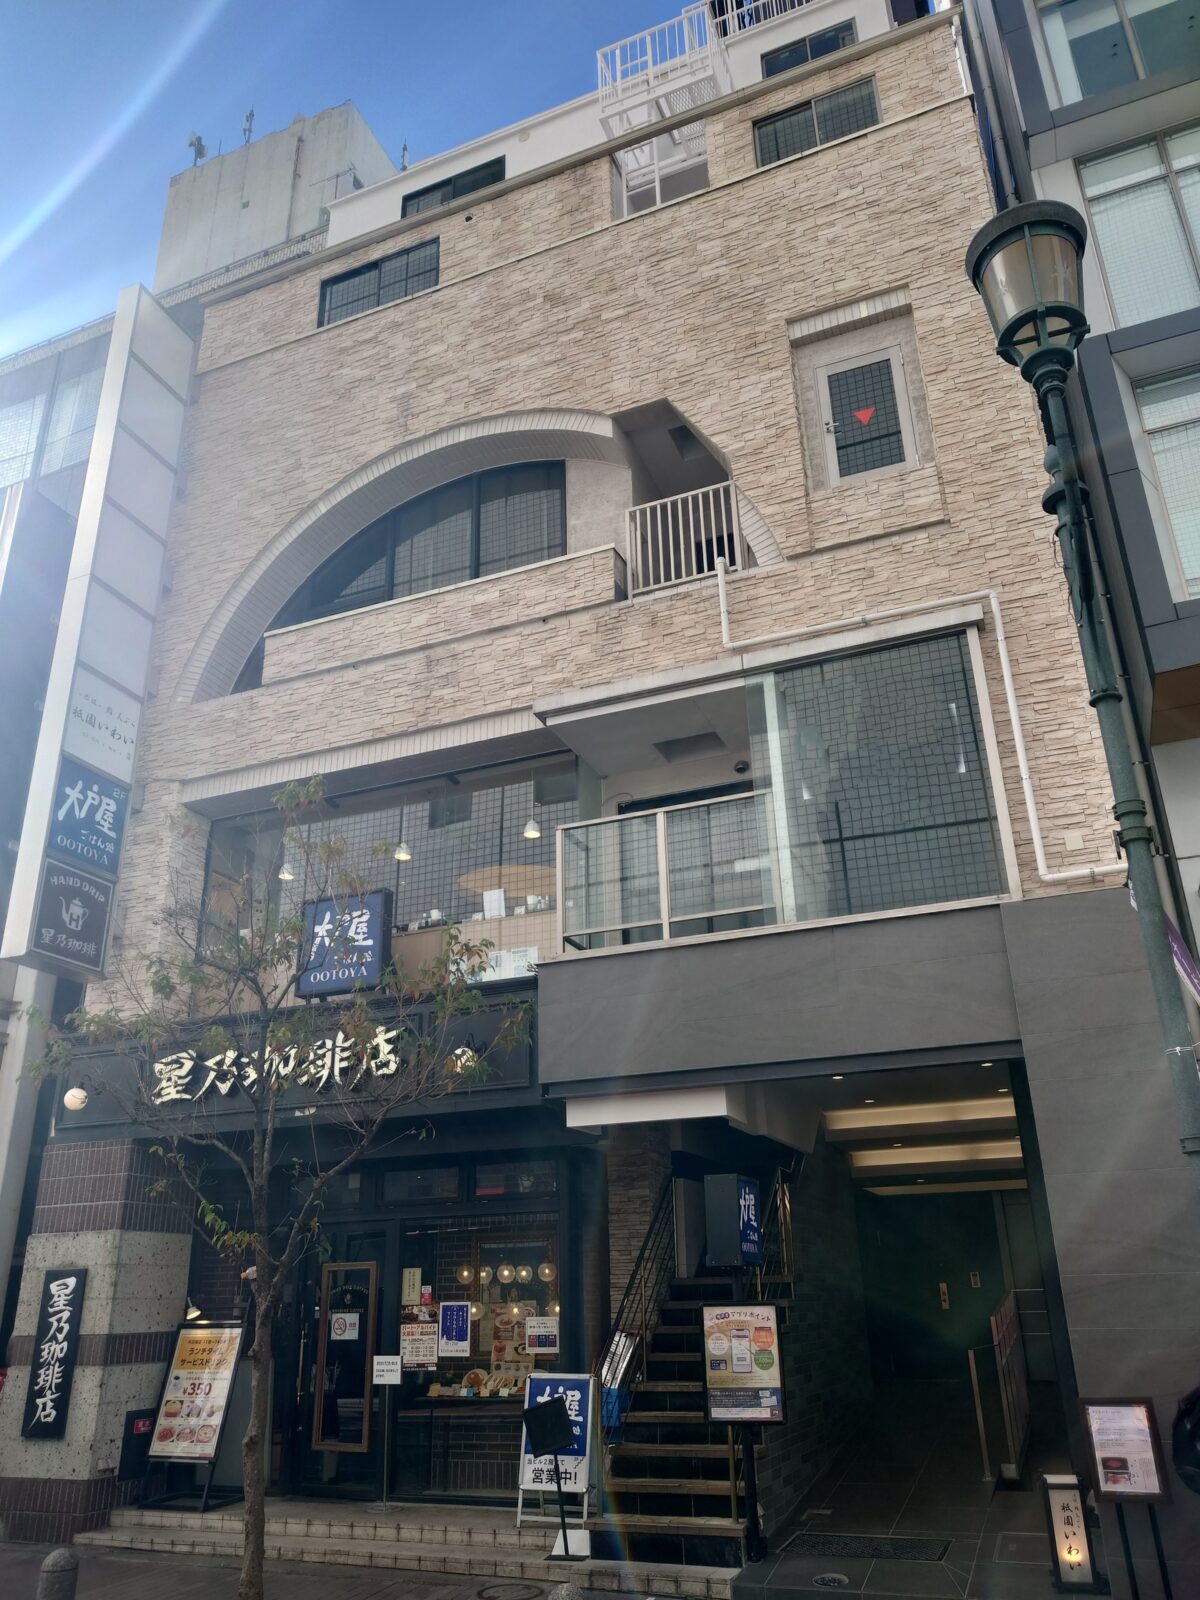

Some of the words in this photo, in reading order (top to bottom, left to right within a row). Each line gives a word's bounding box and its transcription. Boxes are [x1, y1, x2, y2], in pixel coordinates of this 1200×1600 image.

[113, 788, 127, 800] 2F
[57, 780, 117, 839] 大戸屋
[57, 834, 108, 865] OOTOYA
[50, 876, 80, 888] HAND
[81, 881, 105, 903] DRIP
[40, 928, 97, 958] 星乃珈琲
[310, 966, 368, 983] OOTOYA
[151, 1026, 405, 1105] 星乃珈琲店
[740, 1186, 758, 1231] 大戸屋
[28, 1276, 77, 1430] 星乃珈琲店
[182, 1382, 213, 1396] ¥350
[527, 1458, 565, 1466] 当ビル2階て
[532, 1467, 578, 1485] 営業中!
